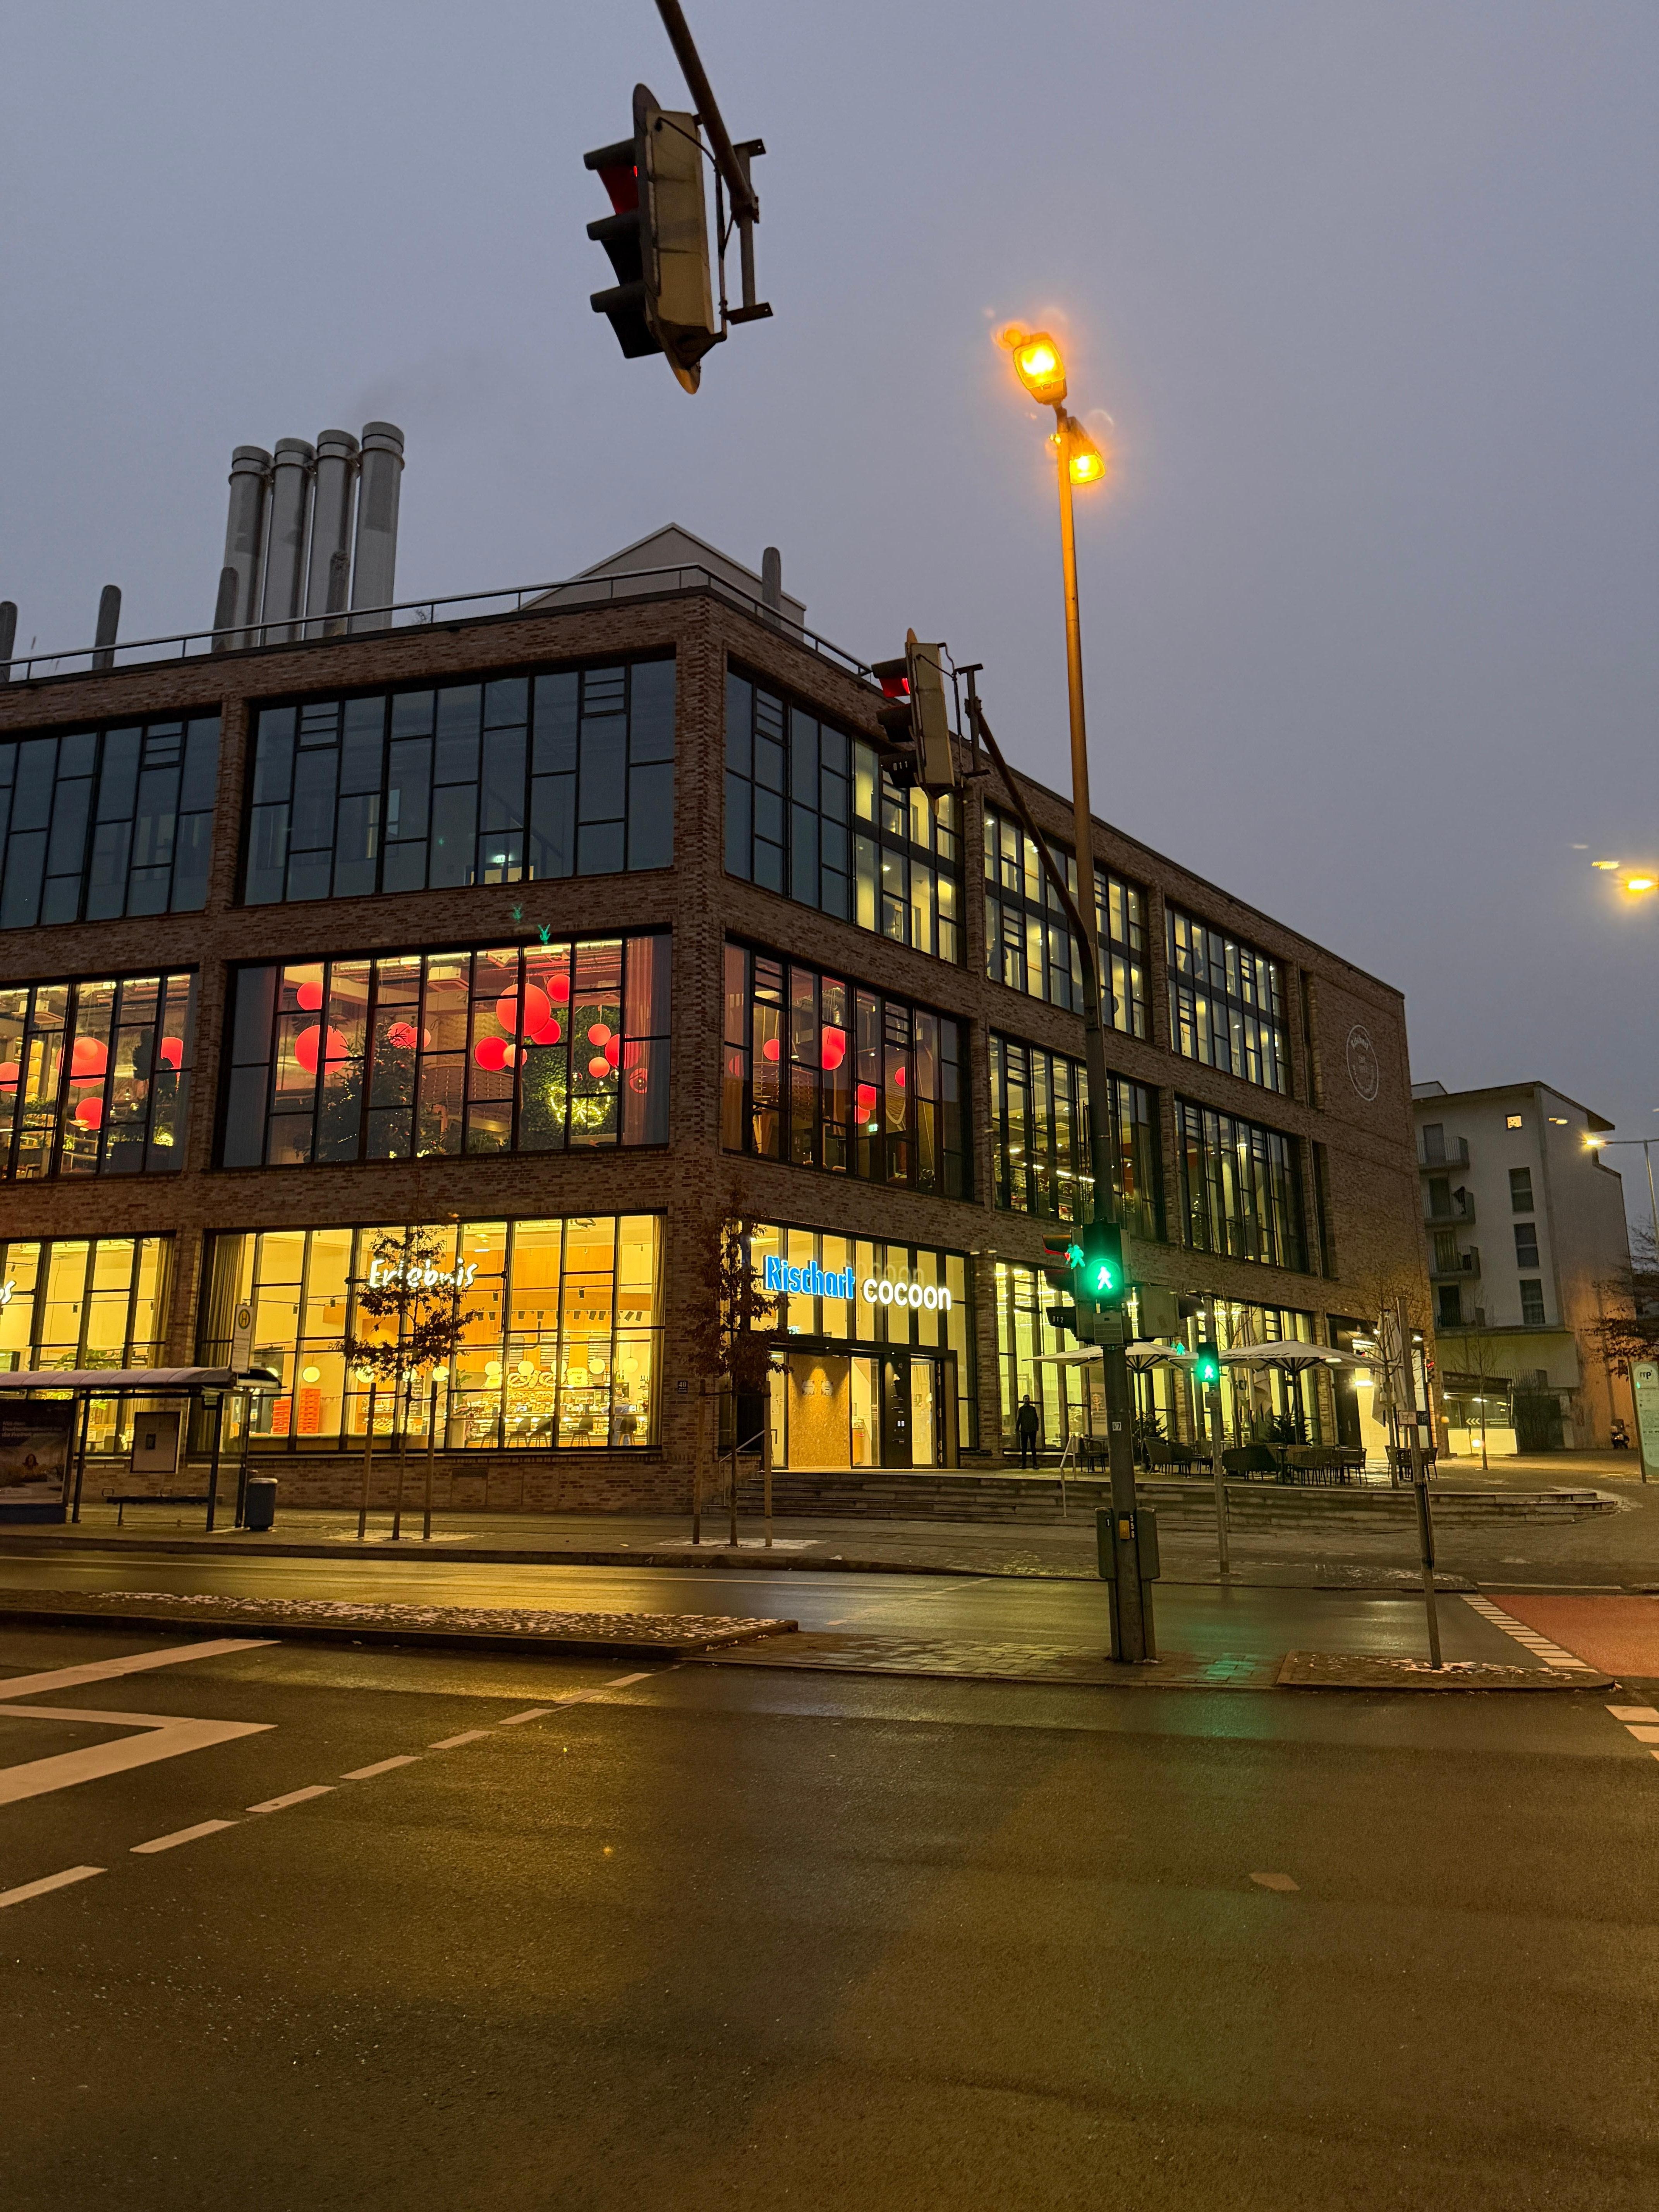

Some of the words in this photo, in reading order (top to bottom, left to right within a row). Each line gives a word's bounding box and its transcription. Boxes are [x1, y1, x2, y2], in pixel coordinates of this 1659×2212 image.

[764, 1255, 855, 1299] Rischart
[863, 1278, 952, 1311] cocoon
[241, 1313, 247, 1325] H
